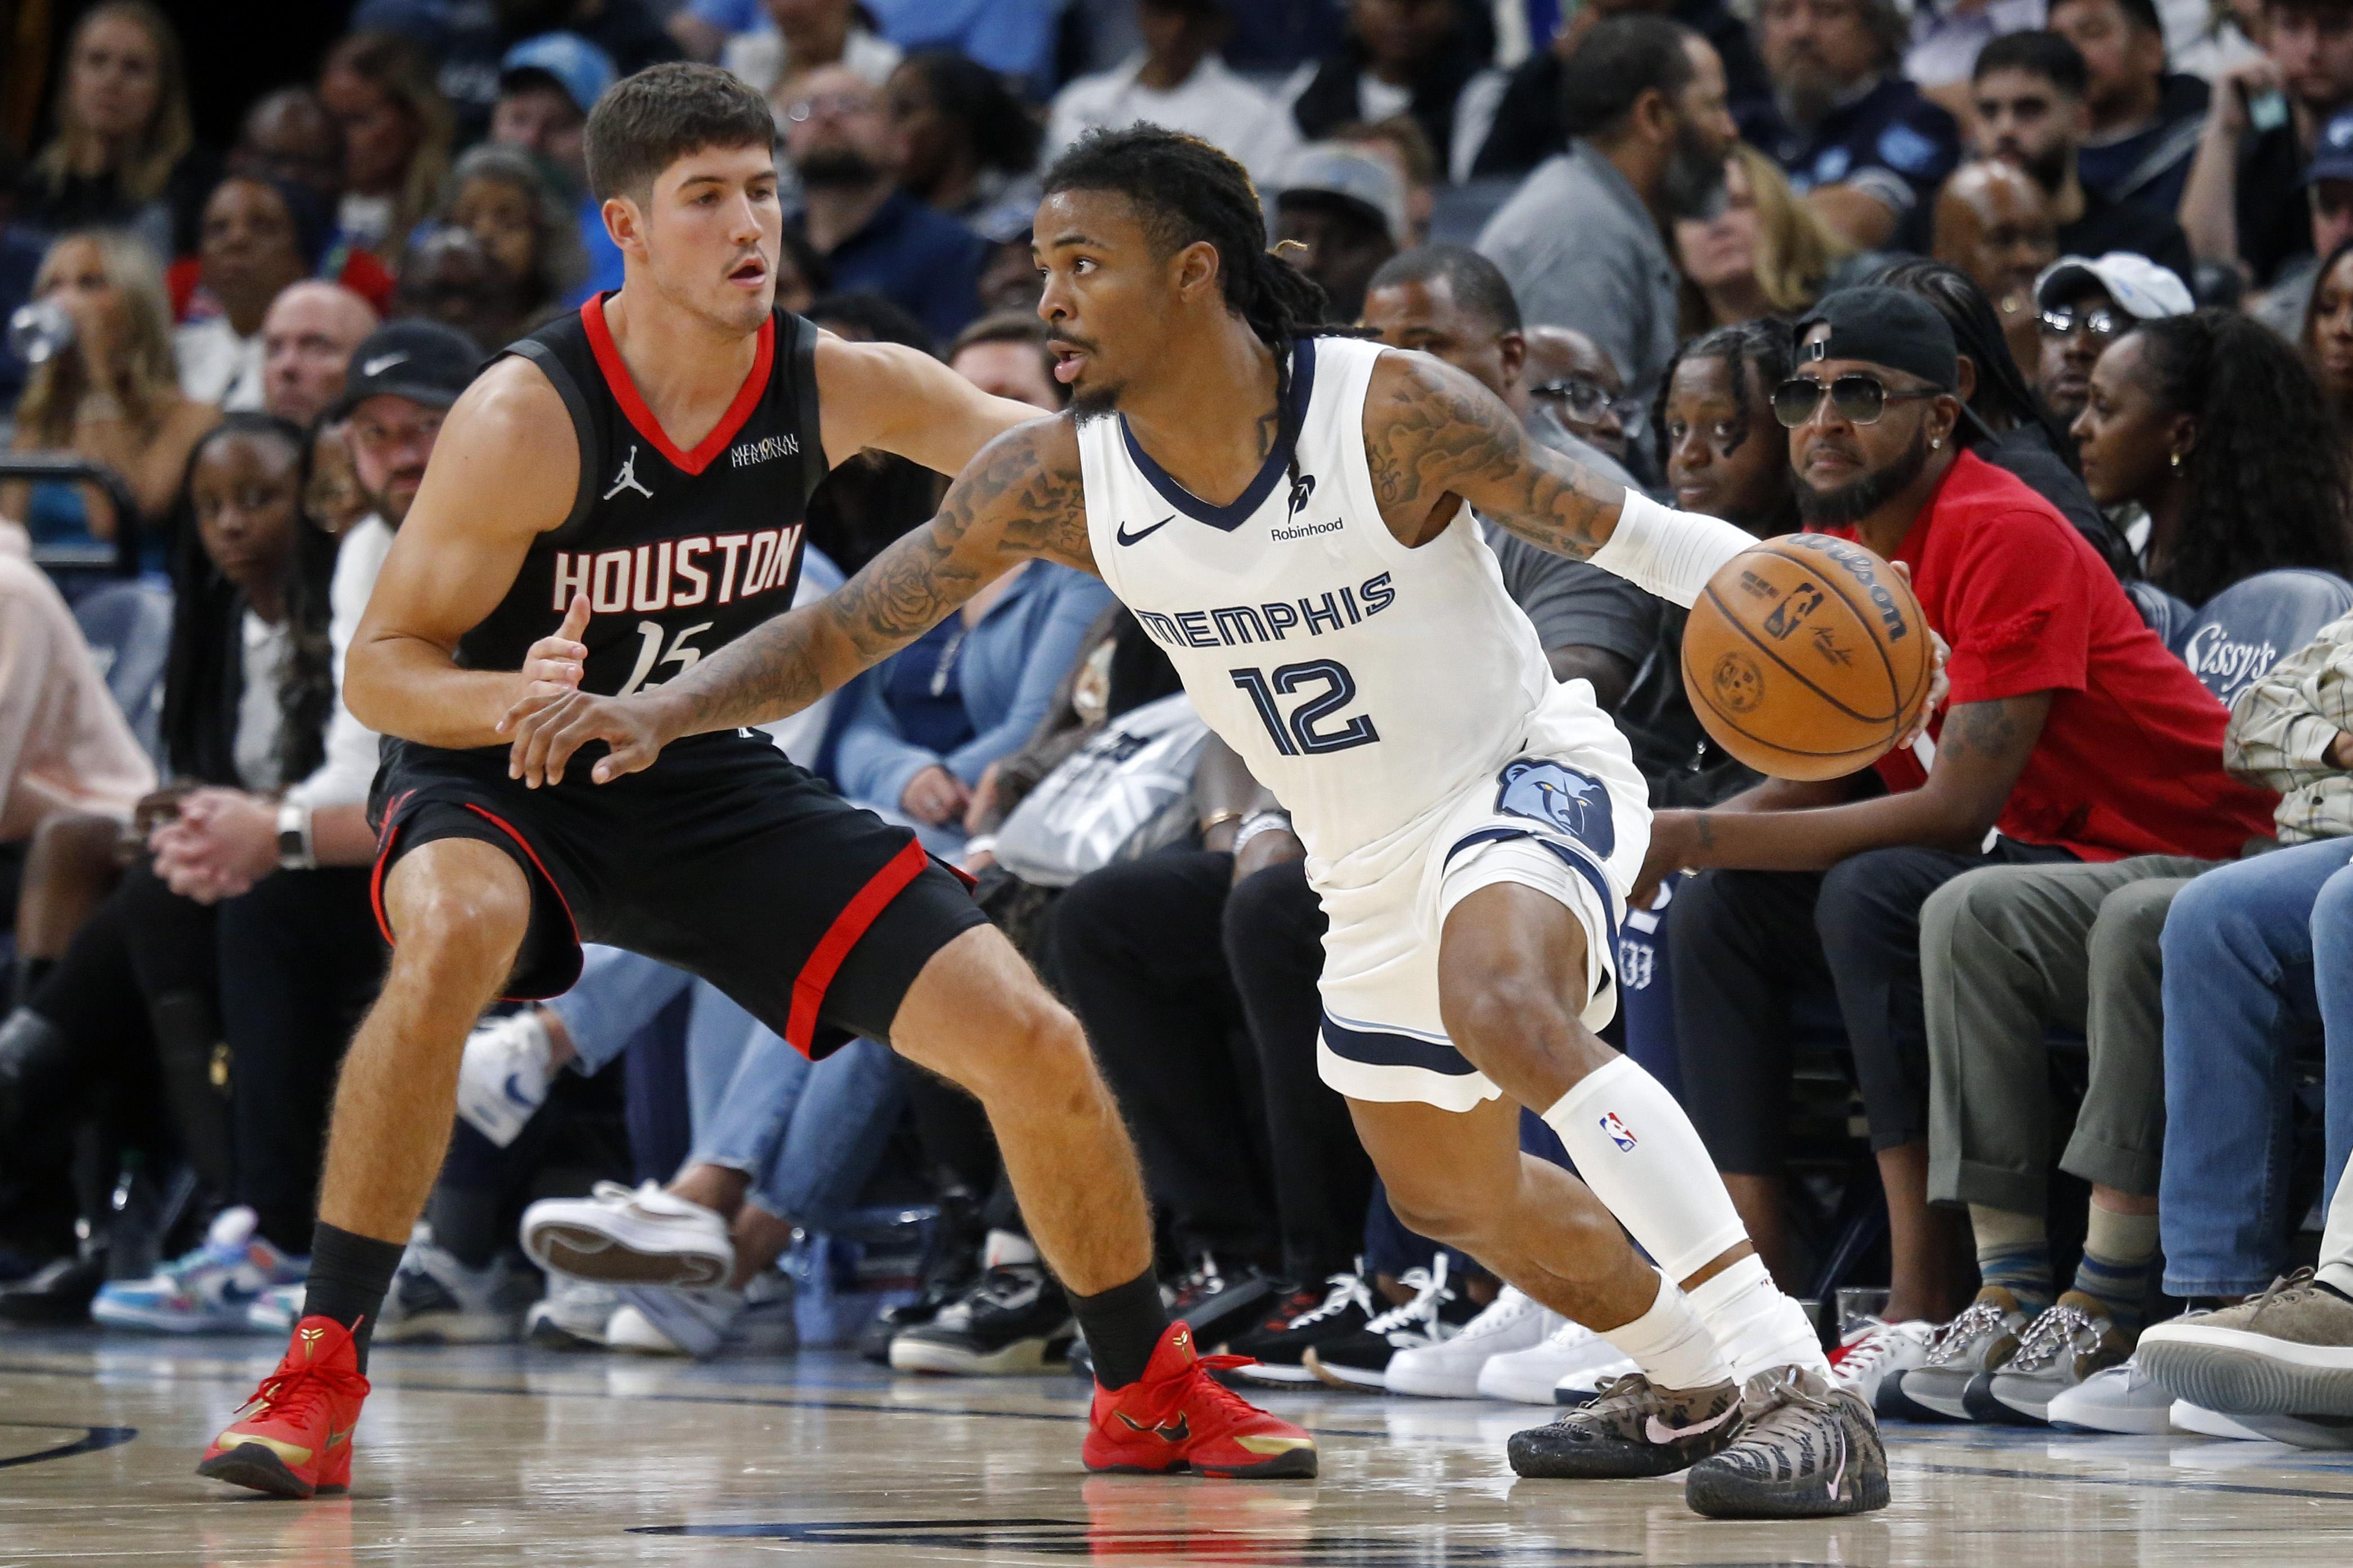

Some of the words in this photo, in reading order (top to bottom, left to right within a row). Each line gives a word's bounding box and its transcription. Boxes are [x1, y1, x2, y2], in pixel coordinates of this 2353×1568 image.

[732, 433, 798, 457] MEMORIAL
[732, 441, 799, 468] HERMANN
[1271, 517, 1343, 541] Robinhood
[552, 522, 804, 614] HOUSTON
[1134, 571, 1396, 648] MEMPHIS
[615, 620, 714, 697] 15
[2185, 622, 2276, 694] Sissy's
[1229, 659, 1380, 756] 12
